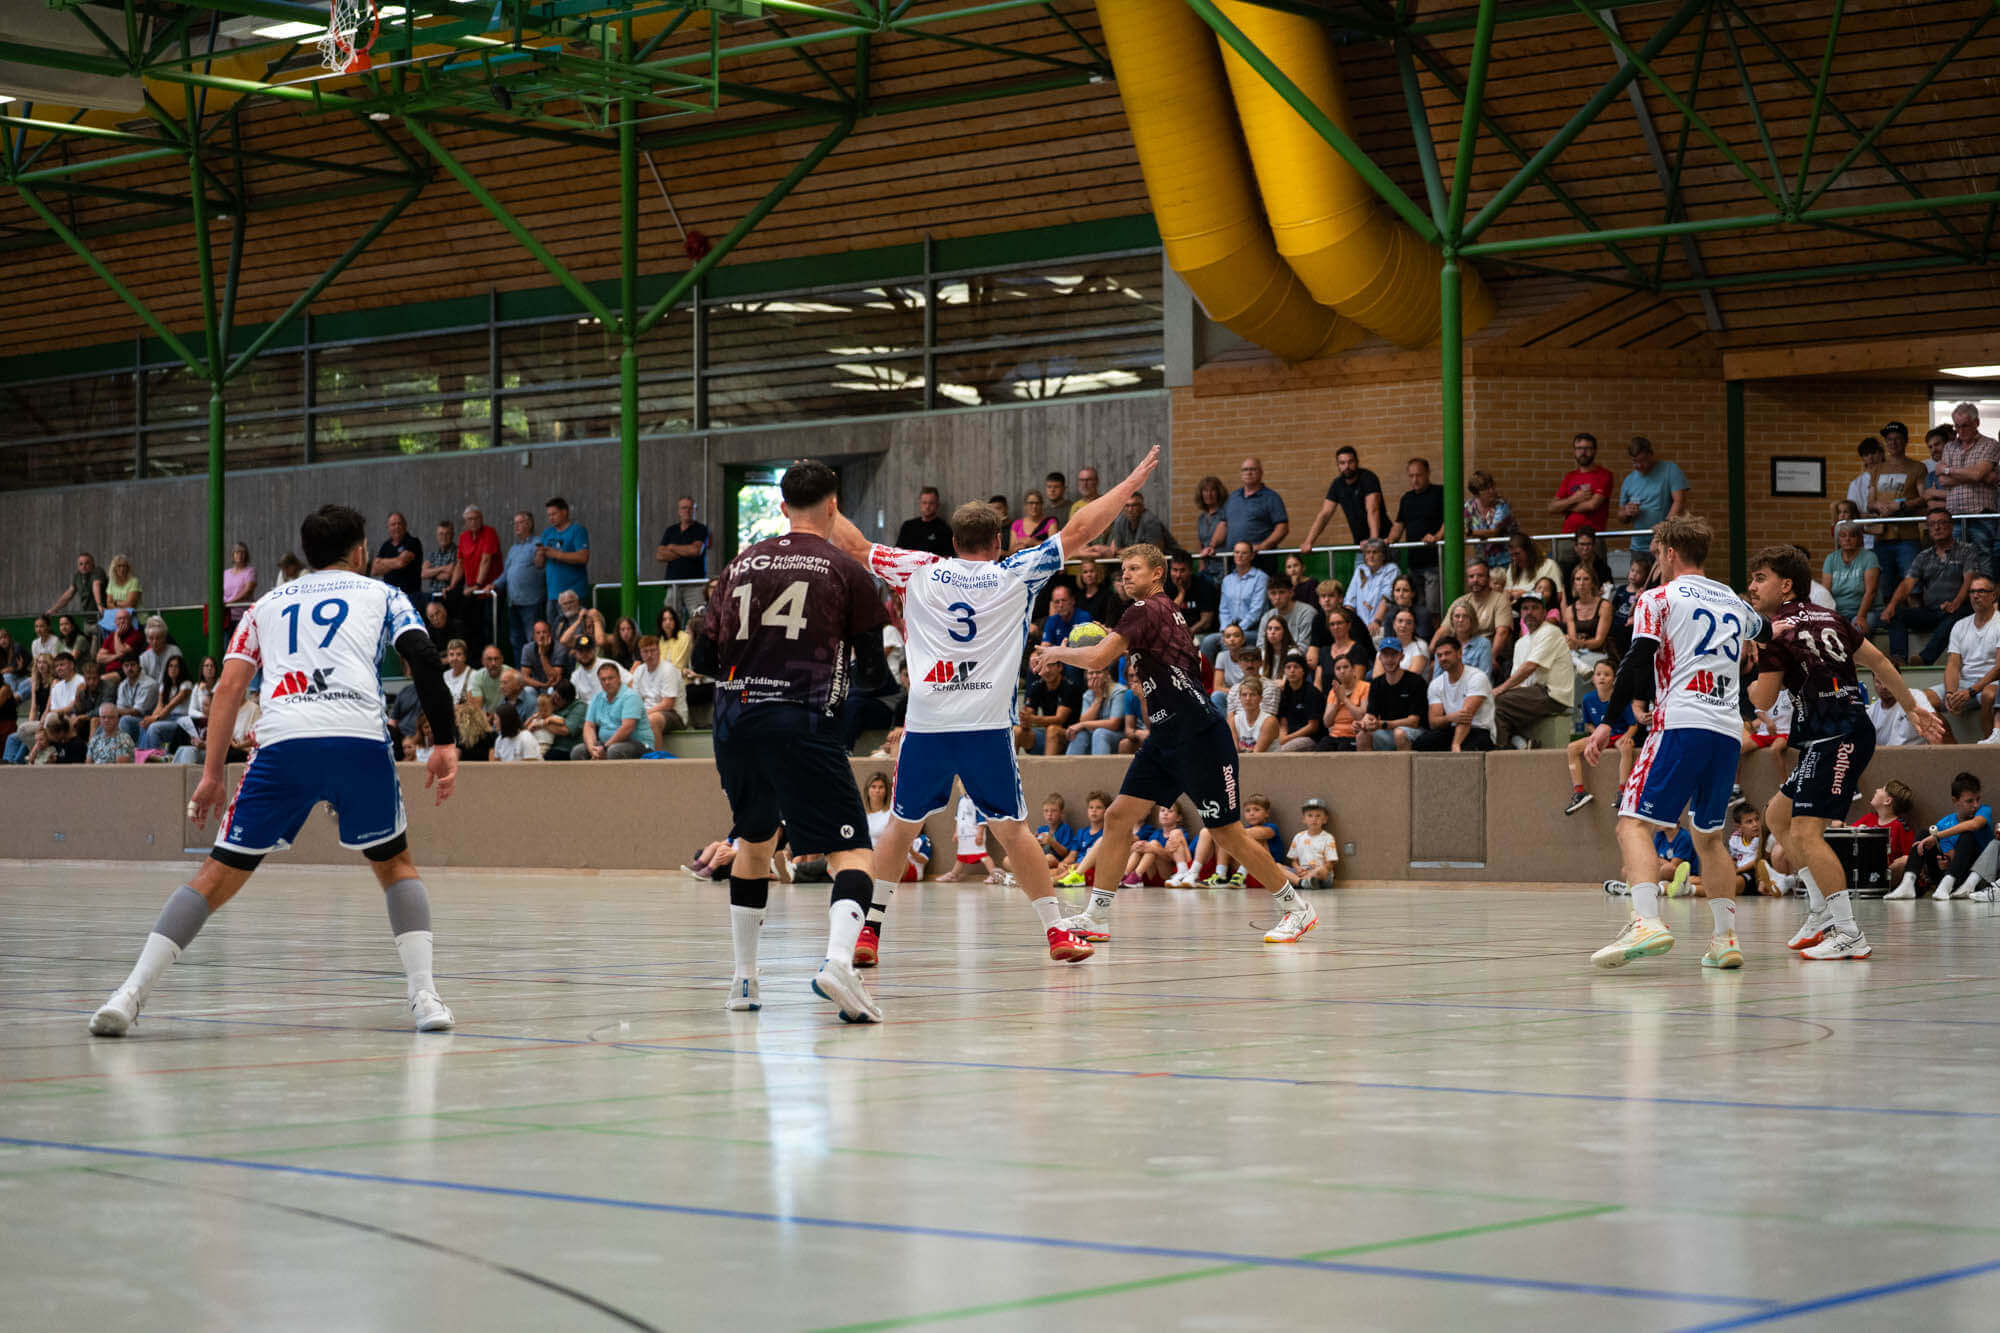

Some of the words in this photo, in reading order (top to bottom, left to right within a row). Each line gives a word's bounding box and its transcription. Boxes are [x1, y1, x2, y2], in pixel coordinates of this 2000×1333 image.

[729, 555, 771, 580] HSG
[773, 554, 831, 567] Fridingen
[931, 568, 952, 584] SG
[271, 585, 299, 600] SG
[1679, 586, 1700, 599] SG
[732, 581, 809, 640] 14
[947, 602, 977, 643] 3
[281, 598, 349, 655] 19
[1692, 607, 1741, 663] 23
[1798, 627, 1848, 663] 10
[932, 681, 993, 692] SCHRAMBERG
